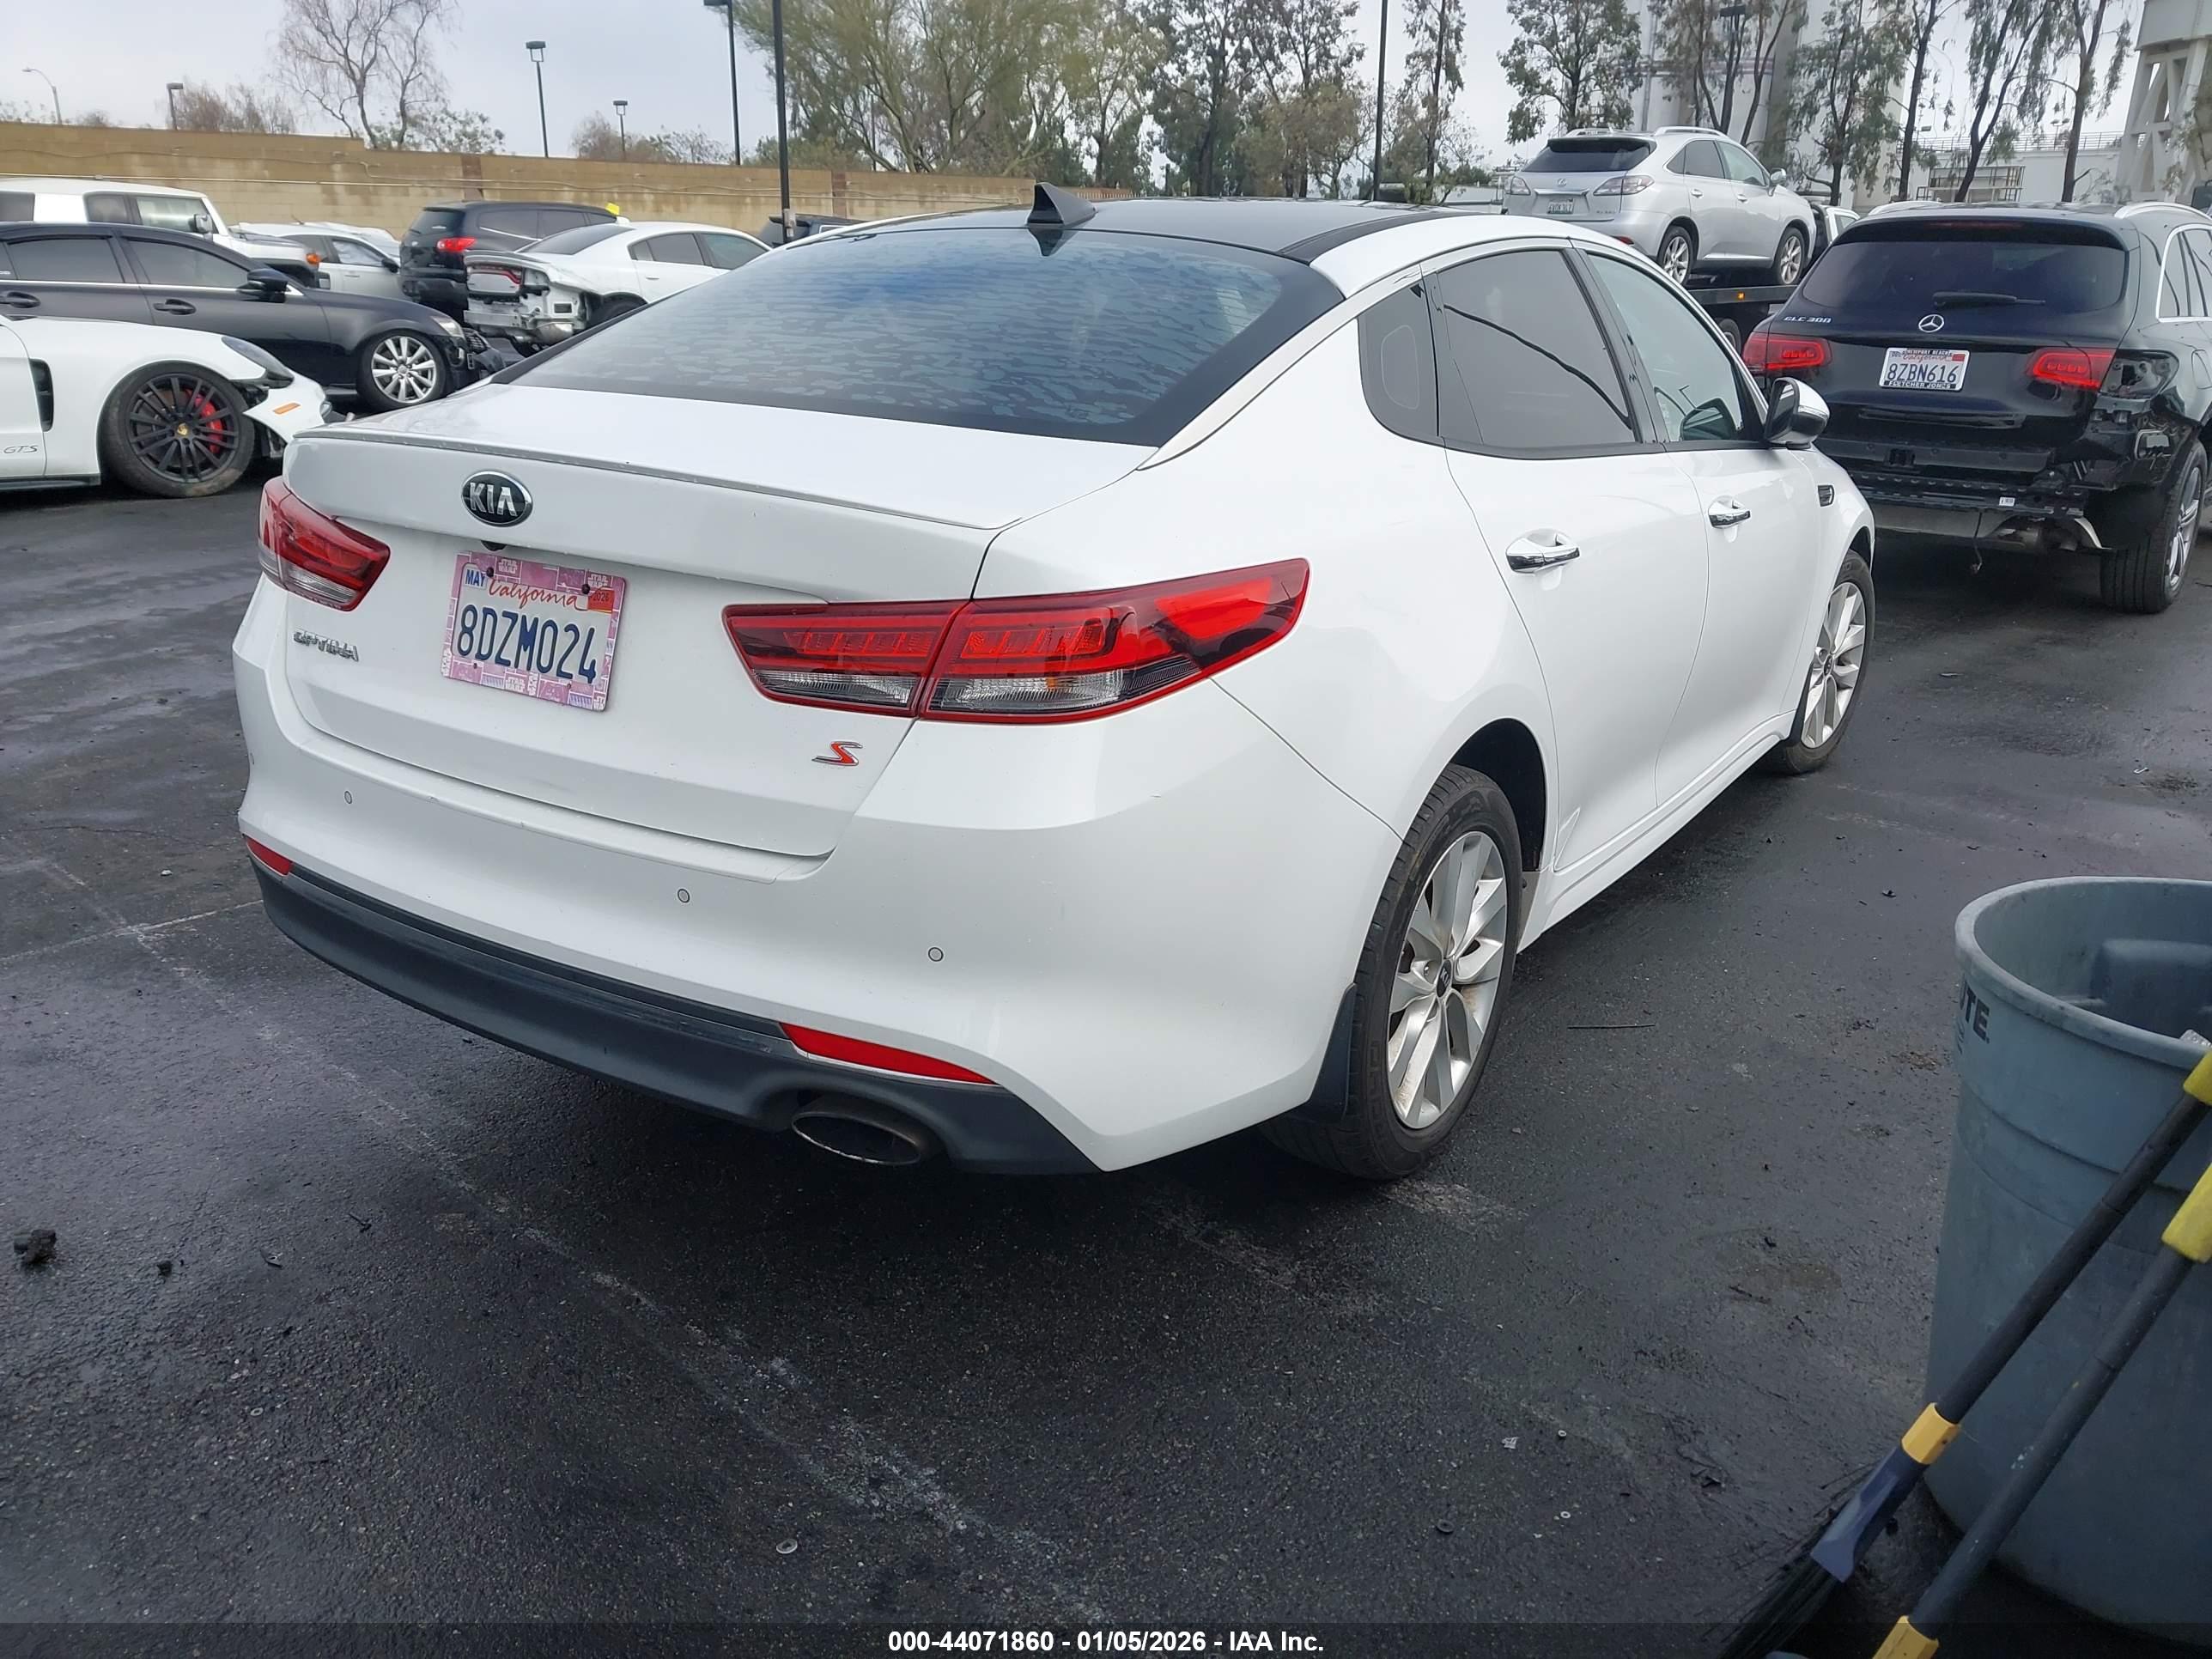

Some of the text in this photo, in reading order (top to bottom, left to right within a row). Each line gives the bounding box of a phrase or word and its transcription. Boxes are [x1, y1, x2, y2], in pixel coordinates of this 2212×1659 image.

[1887, 363, 1960, 383] 8ZBN616
[3, 445, 39, 454] GTS
[470, 482, 518, 517] KIA
[465, 569, 485, 587] MAY
[489, 579, 587, 611] California
[457, 604, 597, 684] 8DZM024
[811, 741, 863, 766] S
